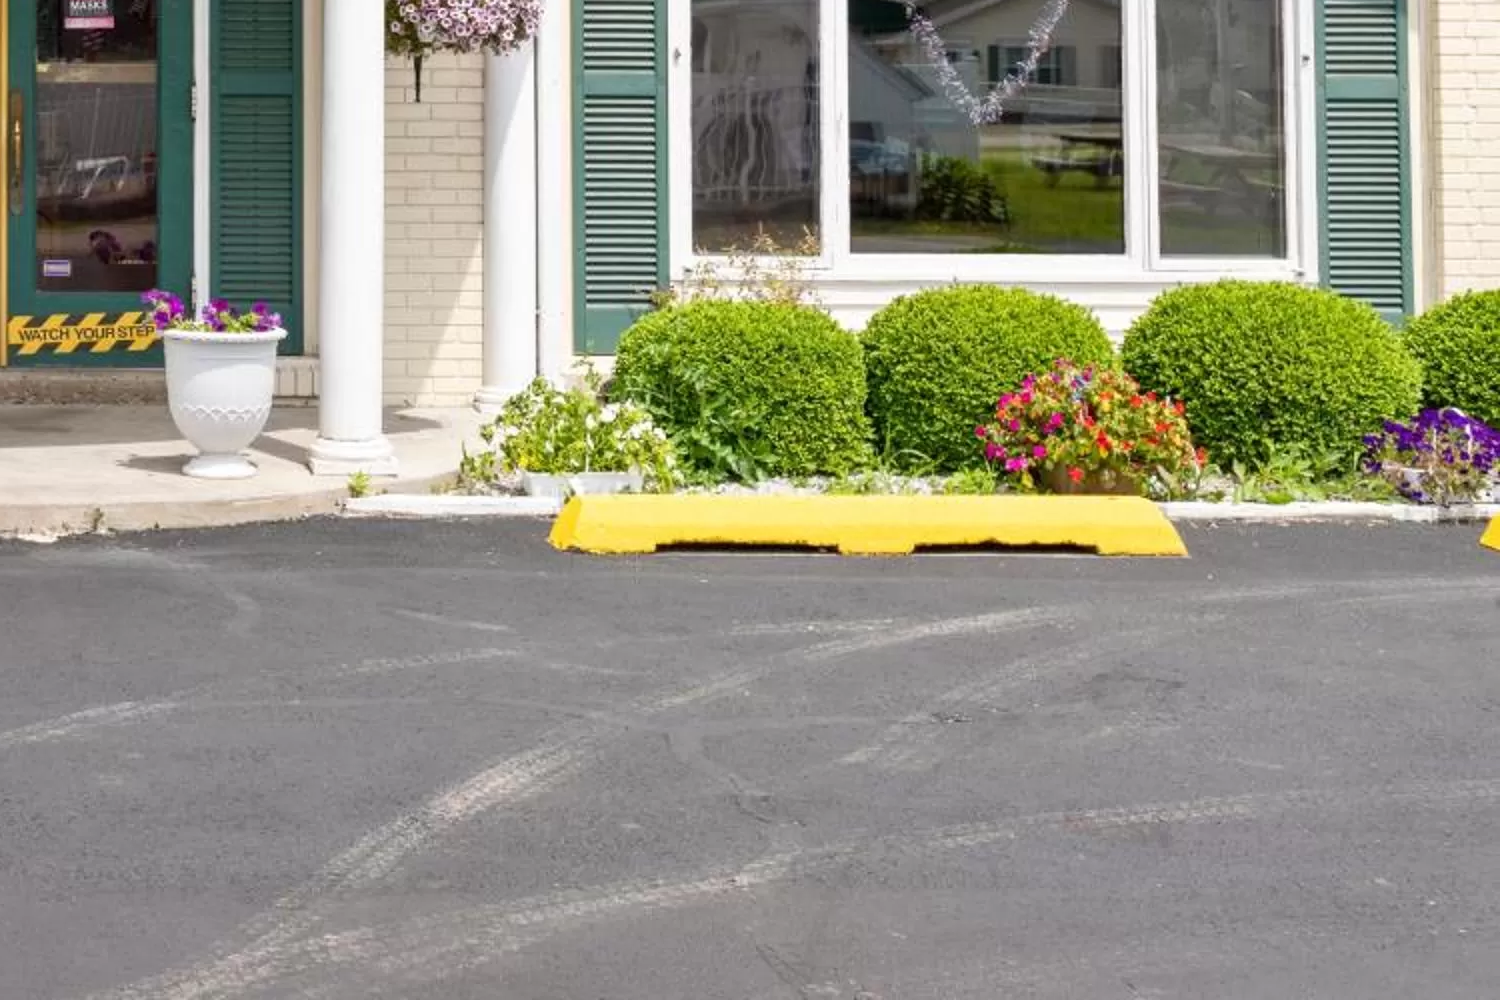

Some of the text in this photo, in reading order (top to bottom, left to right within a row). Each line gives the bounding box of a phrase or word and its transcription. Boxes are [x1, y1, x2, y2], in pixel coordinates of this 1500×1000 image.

[69, 0, 108, 10] MASKS
[18, 324, 155, 342] WATCH YOUR STEP
